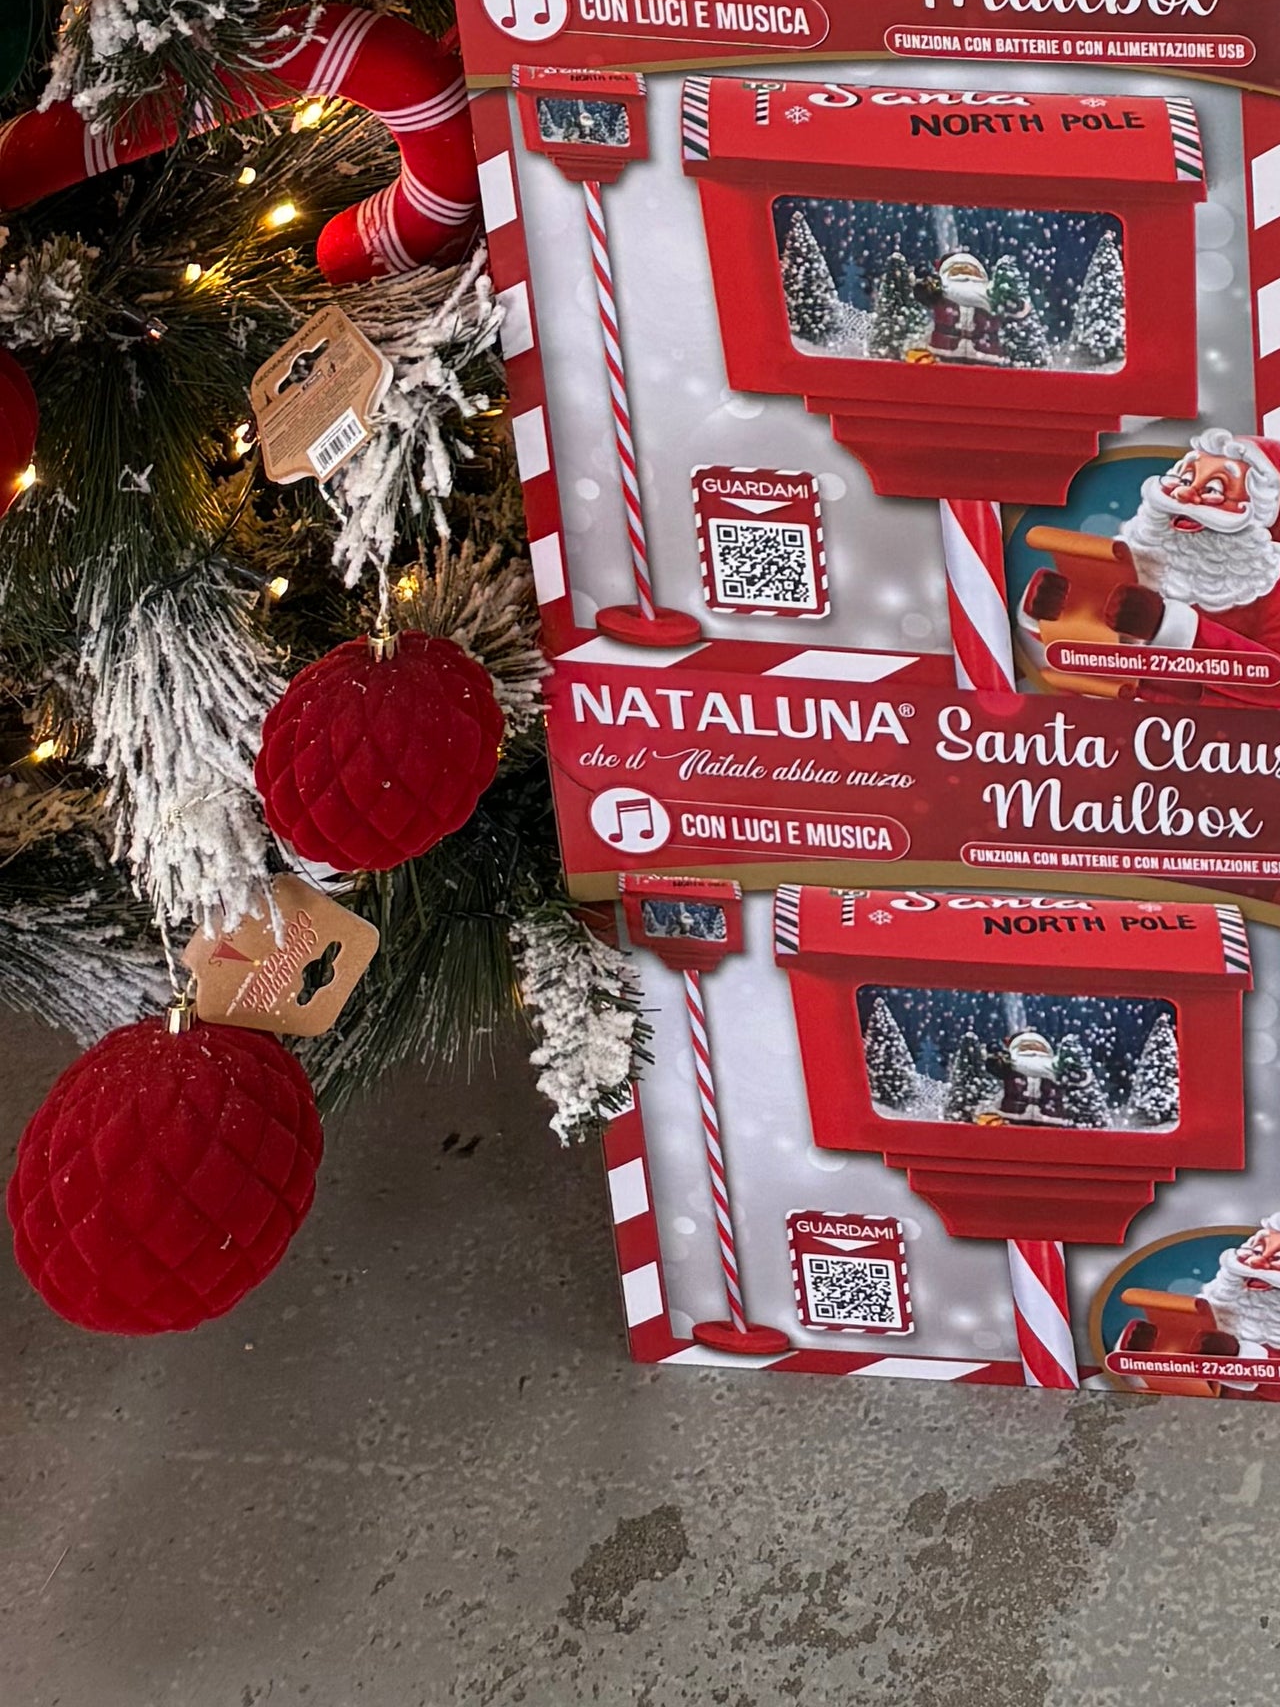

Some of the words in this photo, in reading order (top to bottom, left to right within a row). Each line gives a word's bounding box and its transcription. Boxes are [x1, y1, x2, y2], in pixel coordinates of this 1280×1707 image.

[694, 0, 711, 29] E
[714, 2, 812, 37] MUSICA
[893, 32, 962, 53] FUNZIONA
[963, 34, 993, 54] CON
[995, 35, 1060, 56] BATTERIE
[1062, 38, 1073, 56] O
[1075, 39, 1104, 57] CON
[1106, 40, 1216, 60] ALIMENTAZIONE
[1217, 42, 1246, 61] USB
[910, 112, 1045, 138] NORTH
[1060, 109, 1147, 133] POLE
[701, 477, 811, 501] GUARDAMI
[1060, 648, 1147, 671] Dimensioni:
[1150, 653, 1231, 677] 27x20x150
[1232, 658, 1243, 677] h
[1246, 663, 1270, 680] cm
[935, 705, 1119, 769] Santa
[579, 743, 621, 769] che
[624, 746, 648, 771] il
[652, 747, 767, 781] Natale
[772, 758, 841, 786] abbia
[845, 770, 917, 789] inizio
[982, 777, 1264, 839] Mailbox
[680, 812, 724, 838] CON
[732, 816, 782, 844] LUCI
[787, 820, 802, 845] E
[807, 822, 893, 852] MUSICA
[969, 848, 1031, 865] FUNZIONA
[1033, 850, 1059, 867] CON
[1061, 851, 1120, 869] BATTERIE
[1121, 854, 1131, 870] O
[1133, 855, 1160, 871] CON
[1162, 856, 1260, 874] ALIMENTAZIONE
[982, 914, 1106, 936] NORTH
[1120, 913, 1198, 932] POLE
[795, 1218, 896, 1242] GUARDAMI
[1118, 1356, 1200, 1376] Dimensioni:
[1201, 1359, 1275, 1380] 27x20x150
